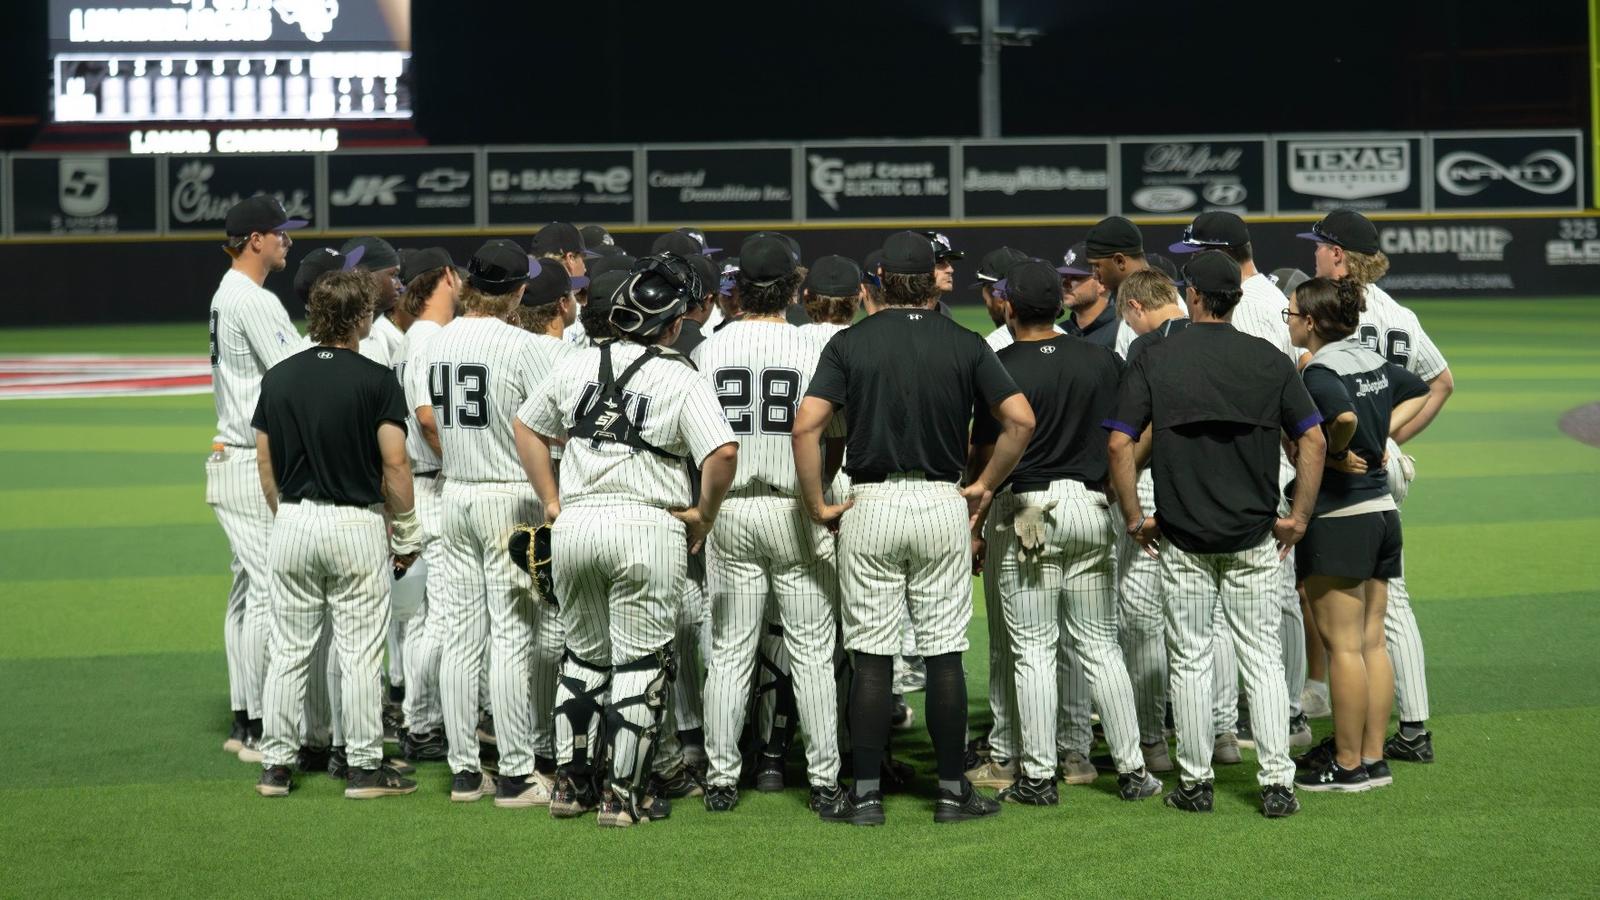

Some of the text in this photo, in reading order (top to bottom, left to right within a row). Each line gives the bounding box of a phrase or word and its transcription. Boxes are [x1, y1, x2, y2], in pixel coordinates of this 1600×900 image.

[1297, 149, 1402, 171] TEXAS
[330, 175, 406, 206] JK
[520, 169, 581, 191] BASF
[1559, 219, 1598, 240] 325
[427, 361, 491, 430] 43
[713, 366, 802, 435] 28
